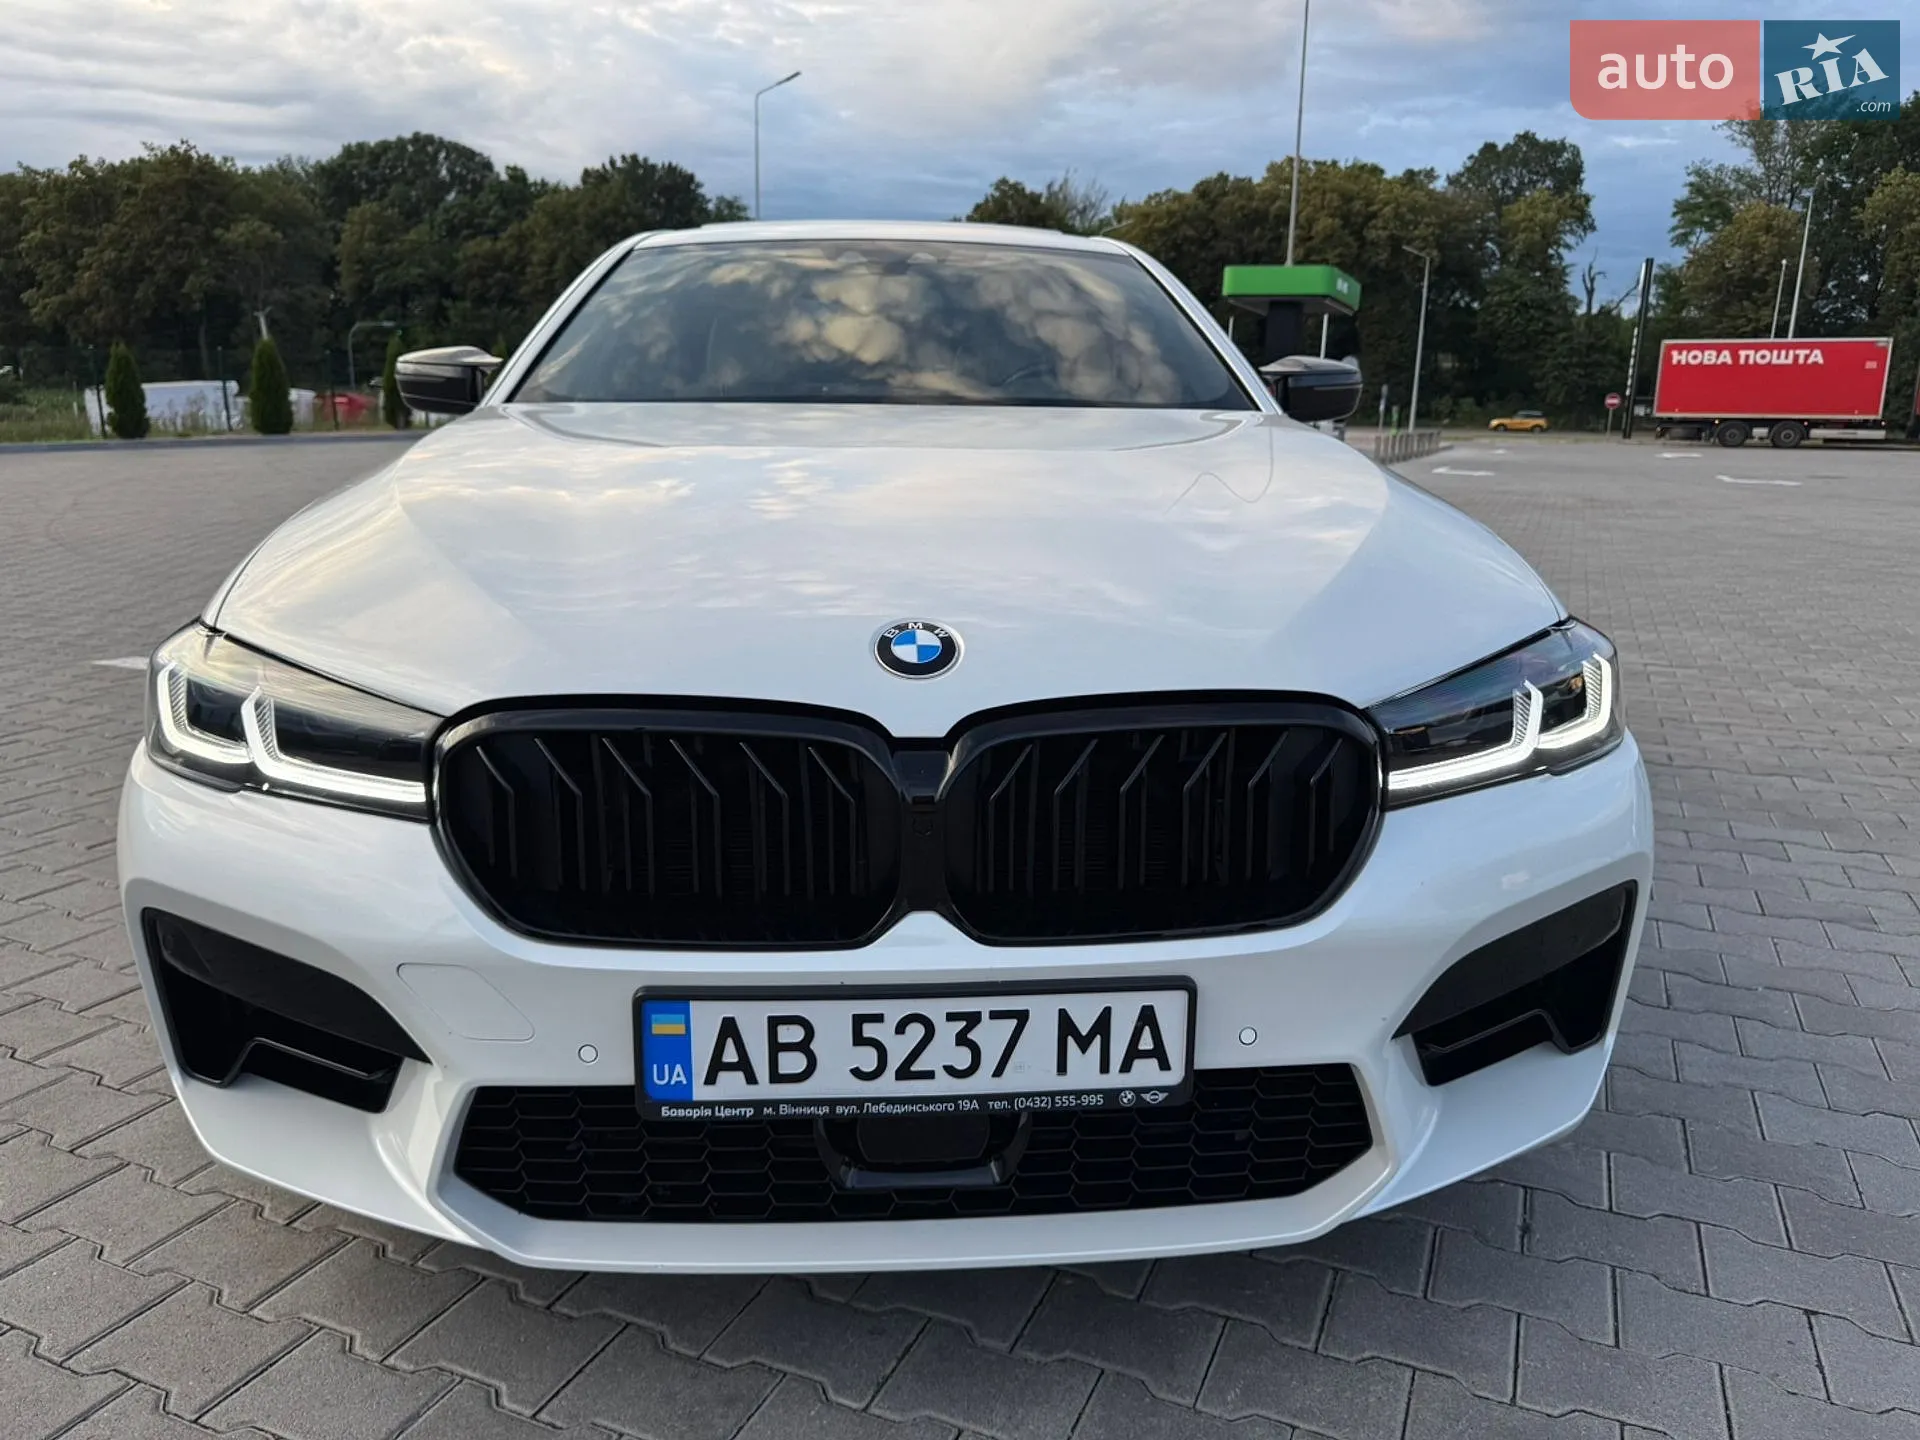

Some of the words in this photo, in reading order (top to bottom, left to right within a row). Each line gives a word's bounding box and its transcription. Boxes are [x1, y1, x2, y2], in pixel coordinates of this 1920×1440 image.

[1671, 349, 1733, 366] НОВА
[1737, 348, 1824, 365] ПОШТА
[882, 622, 949, 639] BMW
[703, 1014, 818, 1086] AB
[849, 1008, 1030, 1082] 5237
[1056, 1004, 1172, 1076] MA
[652, 1063, 688, 1086] UA
[714, 1105, 754, 1118] Центр
[763, 1105, 776, 1116] м.
[778, 1103, 829, 1116] Вінниця
[835, 1104, 860, 1115] вул.
[862, 1101, 955, 1115] Лебединського
[988, 1101, 1011, 1110] тел.
[1014, 1097, 1051, 1111] (0432)
[1055, 1094, 1104, 1107] 555-995
